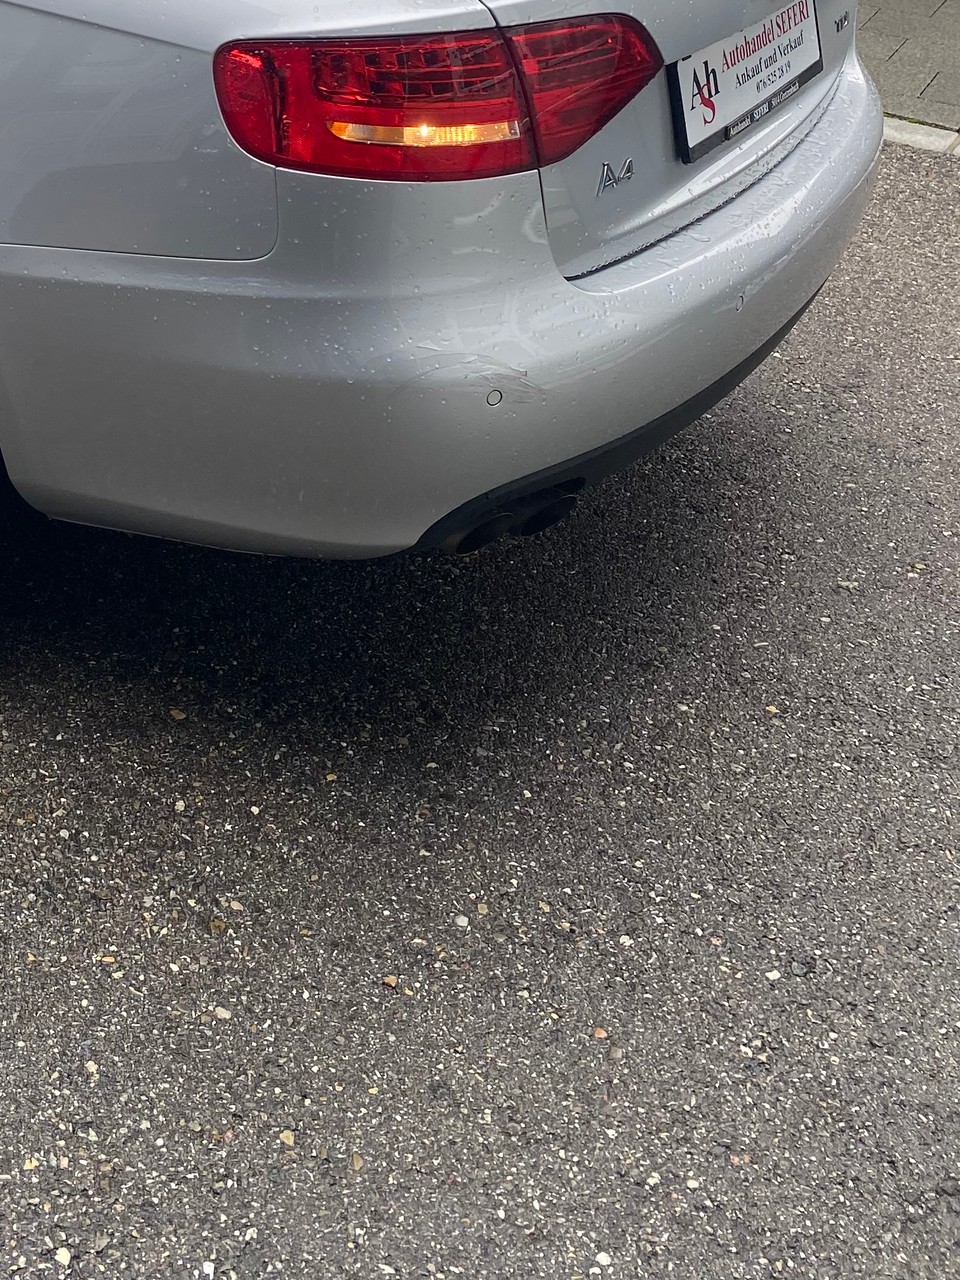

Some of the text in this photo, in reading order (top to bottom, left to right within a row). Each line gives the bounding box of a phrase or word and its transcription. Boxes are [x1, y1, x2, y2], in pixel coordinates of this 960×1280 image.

[722, 19, 776, 73] Autohandel
[735, 30, 804, 89] Ankauf und Verkauf
[595, 157, 635, 198] A4
